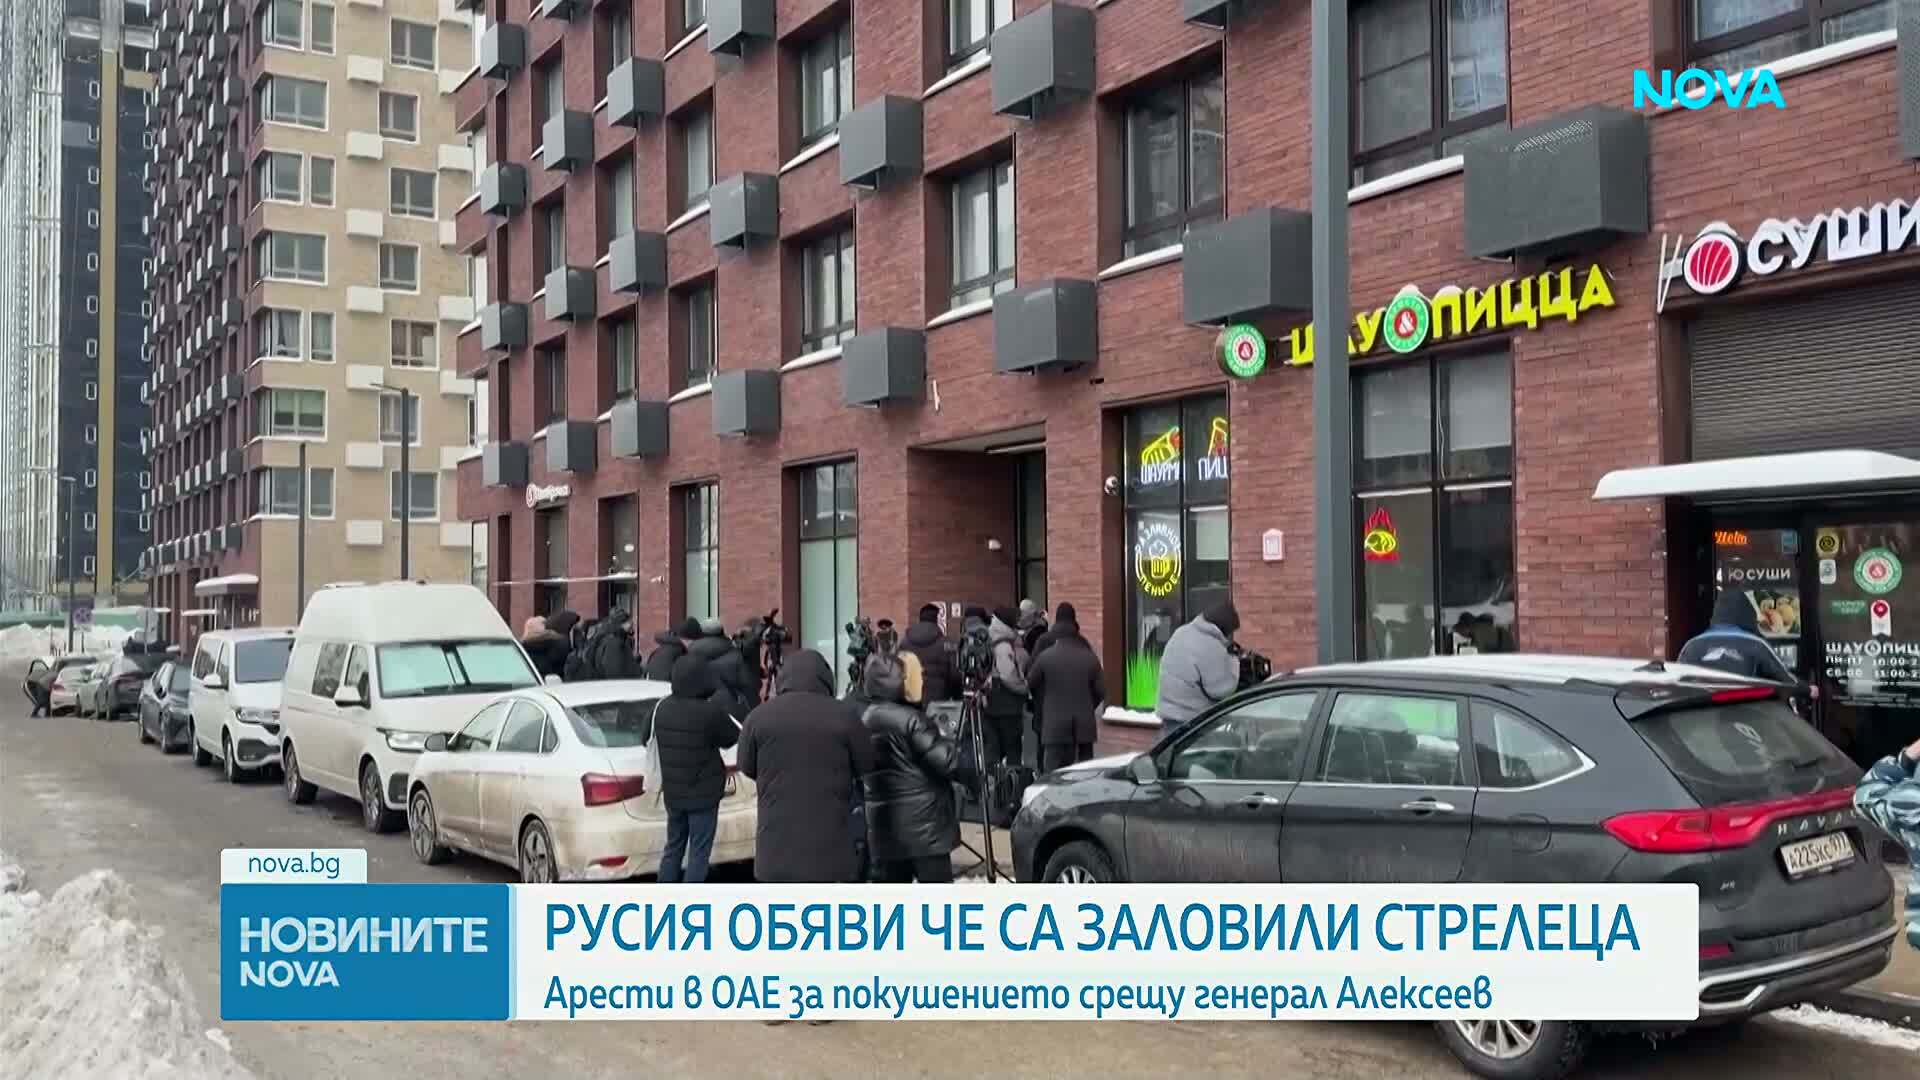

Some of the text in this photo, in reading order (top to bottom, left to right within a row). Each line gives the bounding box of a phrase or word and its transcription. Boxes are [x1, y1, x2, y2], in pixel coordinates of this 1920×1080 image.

[1747, 198, 1920, 275] СУШИ
[1291, 308, 1384, 366] ШУ
[1431, 263, 1616, 340] ПИЦЦА
[1141, 461, 1180, 484] ШАУРМ
[1198, 456, 1228, 480] ПИЦ
[1140, 574, 1178, 597] ПЕННОЕ
[1882, 642, 1919, 656] ПИЦ
